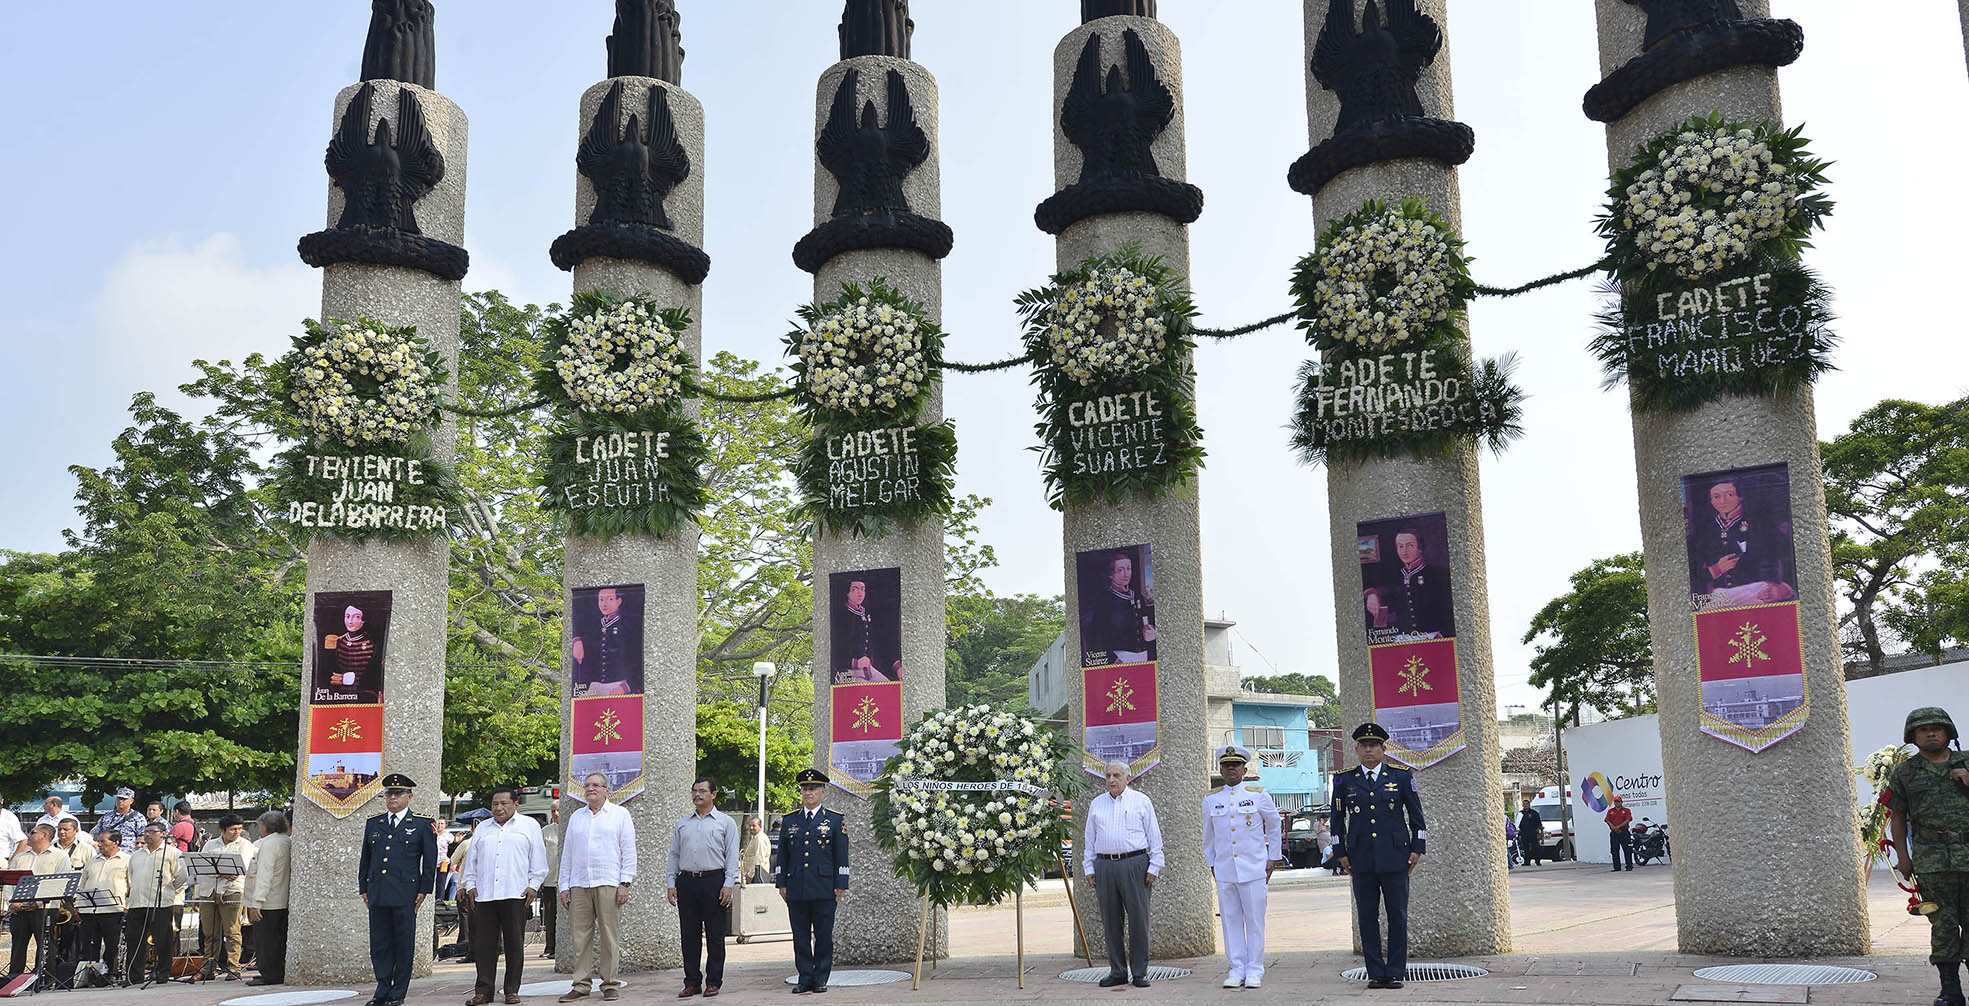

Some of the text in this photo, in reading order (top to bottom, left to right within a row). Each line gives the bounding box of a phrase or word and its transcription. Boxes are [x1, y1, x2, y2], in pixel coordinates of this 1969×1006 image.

[1657, 272, 1772, 321] CADETE
[1627, 304, 1803, 353] FRANCISCO
[1318, 349, 1437, 392] CADETE
[1068, 390, 1163, 427] CADETE
[1316, 378, 1460, 418] FERNANDO
[575, 431, 671, 464] CADETE
[826, 426, 918, 461] CADETE
[1071, 417, 1164, 451] VICENTE
[306, 455, 425, 485] TENIENTE
[588, 455, 660, 482] JUAN
[829, 454, 920, 483] AGUSTIN
[1072, 442, 1167, 475] SUAREZ
[332, 479, 394, 503] JUAN
[564, 481, 671, 509] ESCUTIA
[829, 476, 921, 509] MELGAR
[902, 781, 919, 789] LOS
[955, 782, 997, 790] HEROES
[999, 781, 1013, 790] DE
[1615, 772, 1662, 791] Centro
